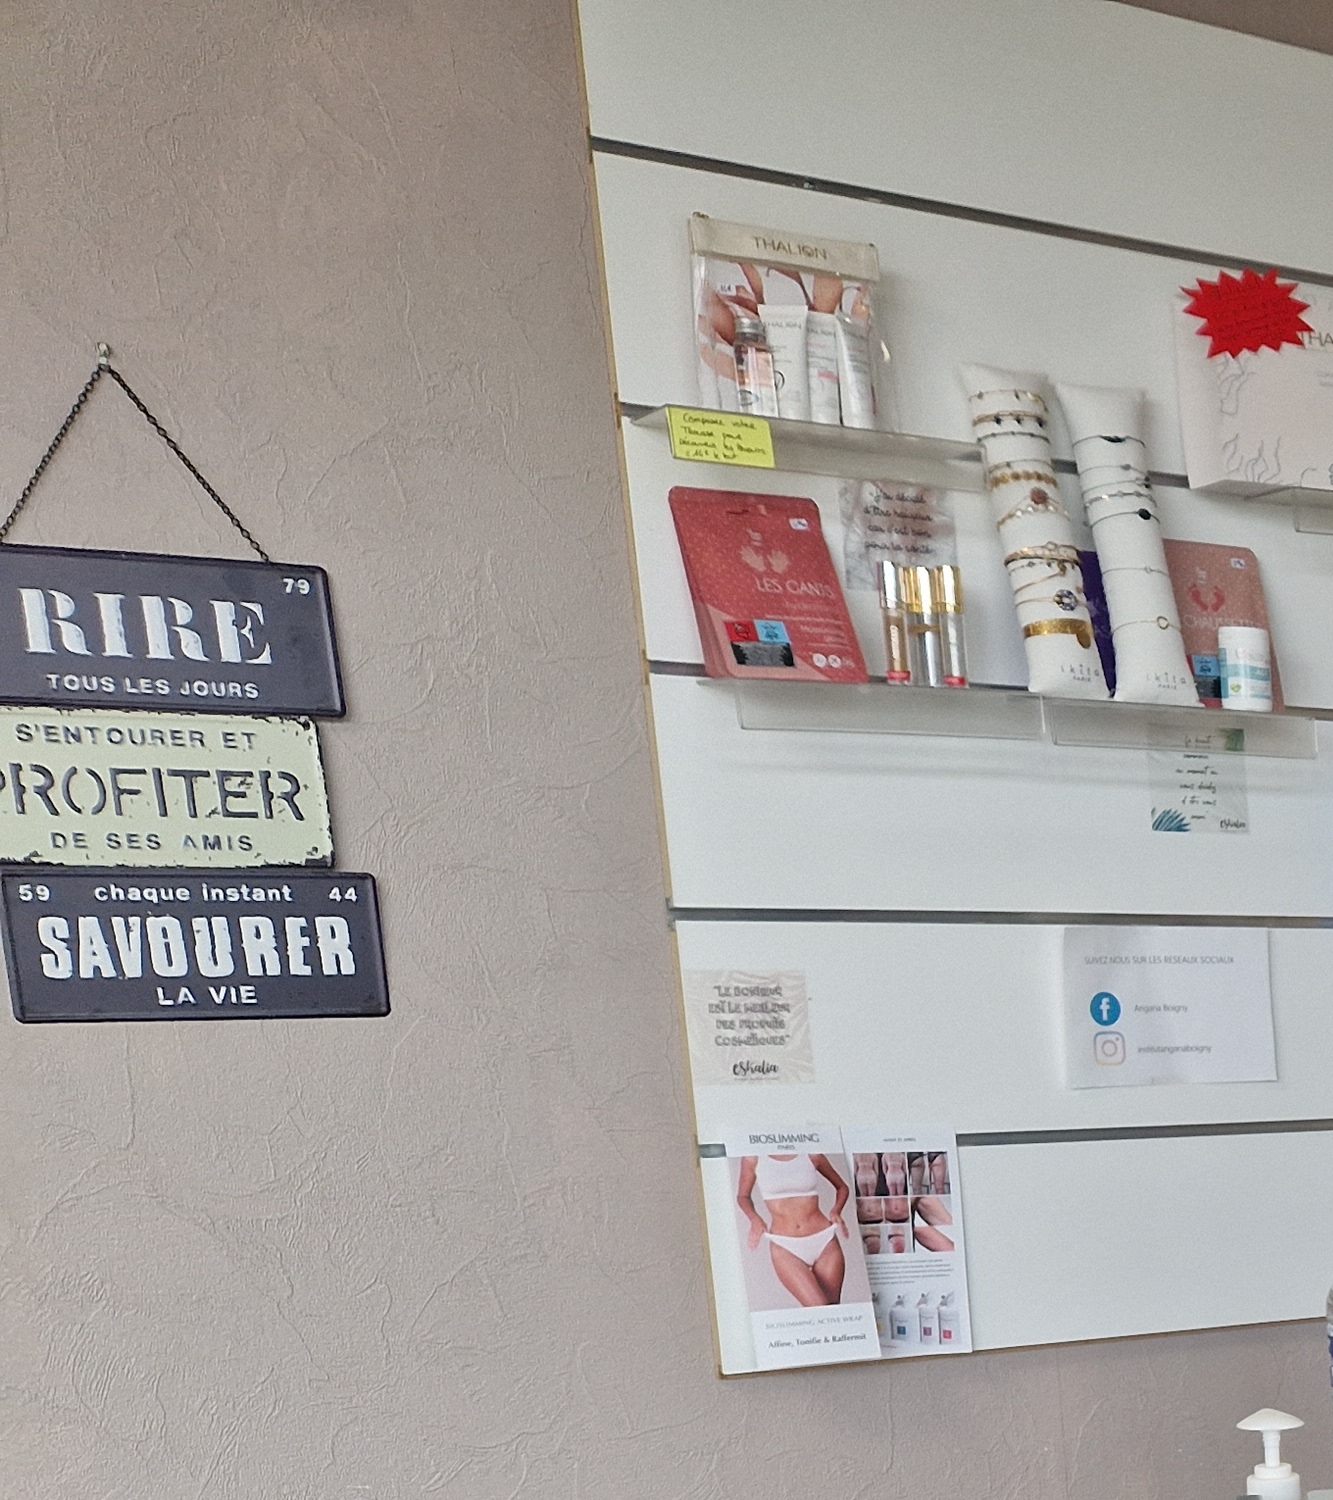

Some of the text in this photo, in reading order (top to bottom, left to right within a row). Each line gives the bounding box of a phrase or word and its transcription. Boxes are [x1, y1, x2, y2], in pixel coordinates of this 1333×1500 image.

[753, 235, 827, 262] THALION
[283, 578, 311, 595] 79
[755, 576, 835, 599] LES GANTS
[18, 587, 272, 665] RIRE
[47, 672, 259, 699] TOUS LES JOURS
[15, 723, 257, 750] S'ENTOURER ET
[0, 763, 305, 822] ROFITER
[51, 831, 254, 852] DE SES AMIS
[18, 882, 358, 903] 59 chaque instant 44
[37, 914, 357, 981] SAVOURER
[157, 985, 258, 1007] LA VIE
[748, 1132, 820, 1145] BIOSLIMMING
